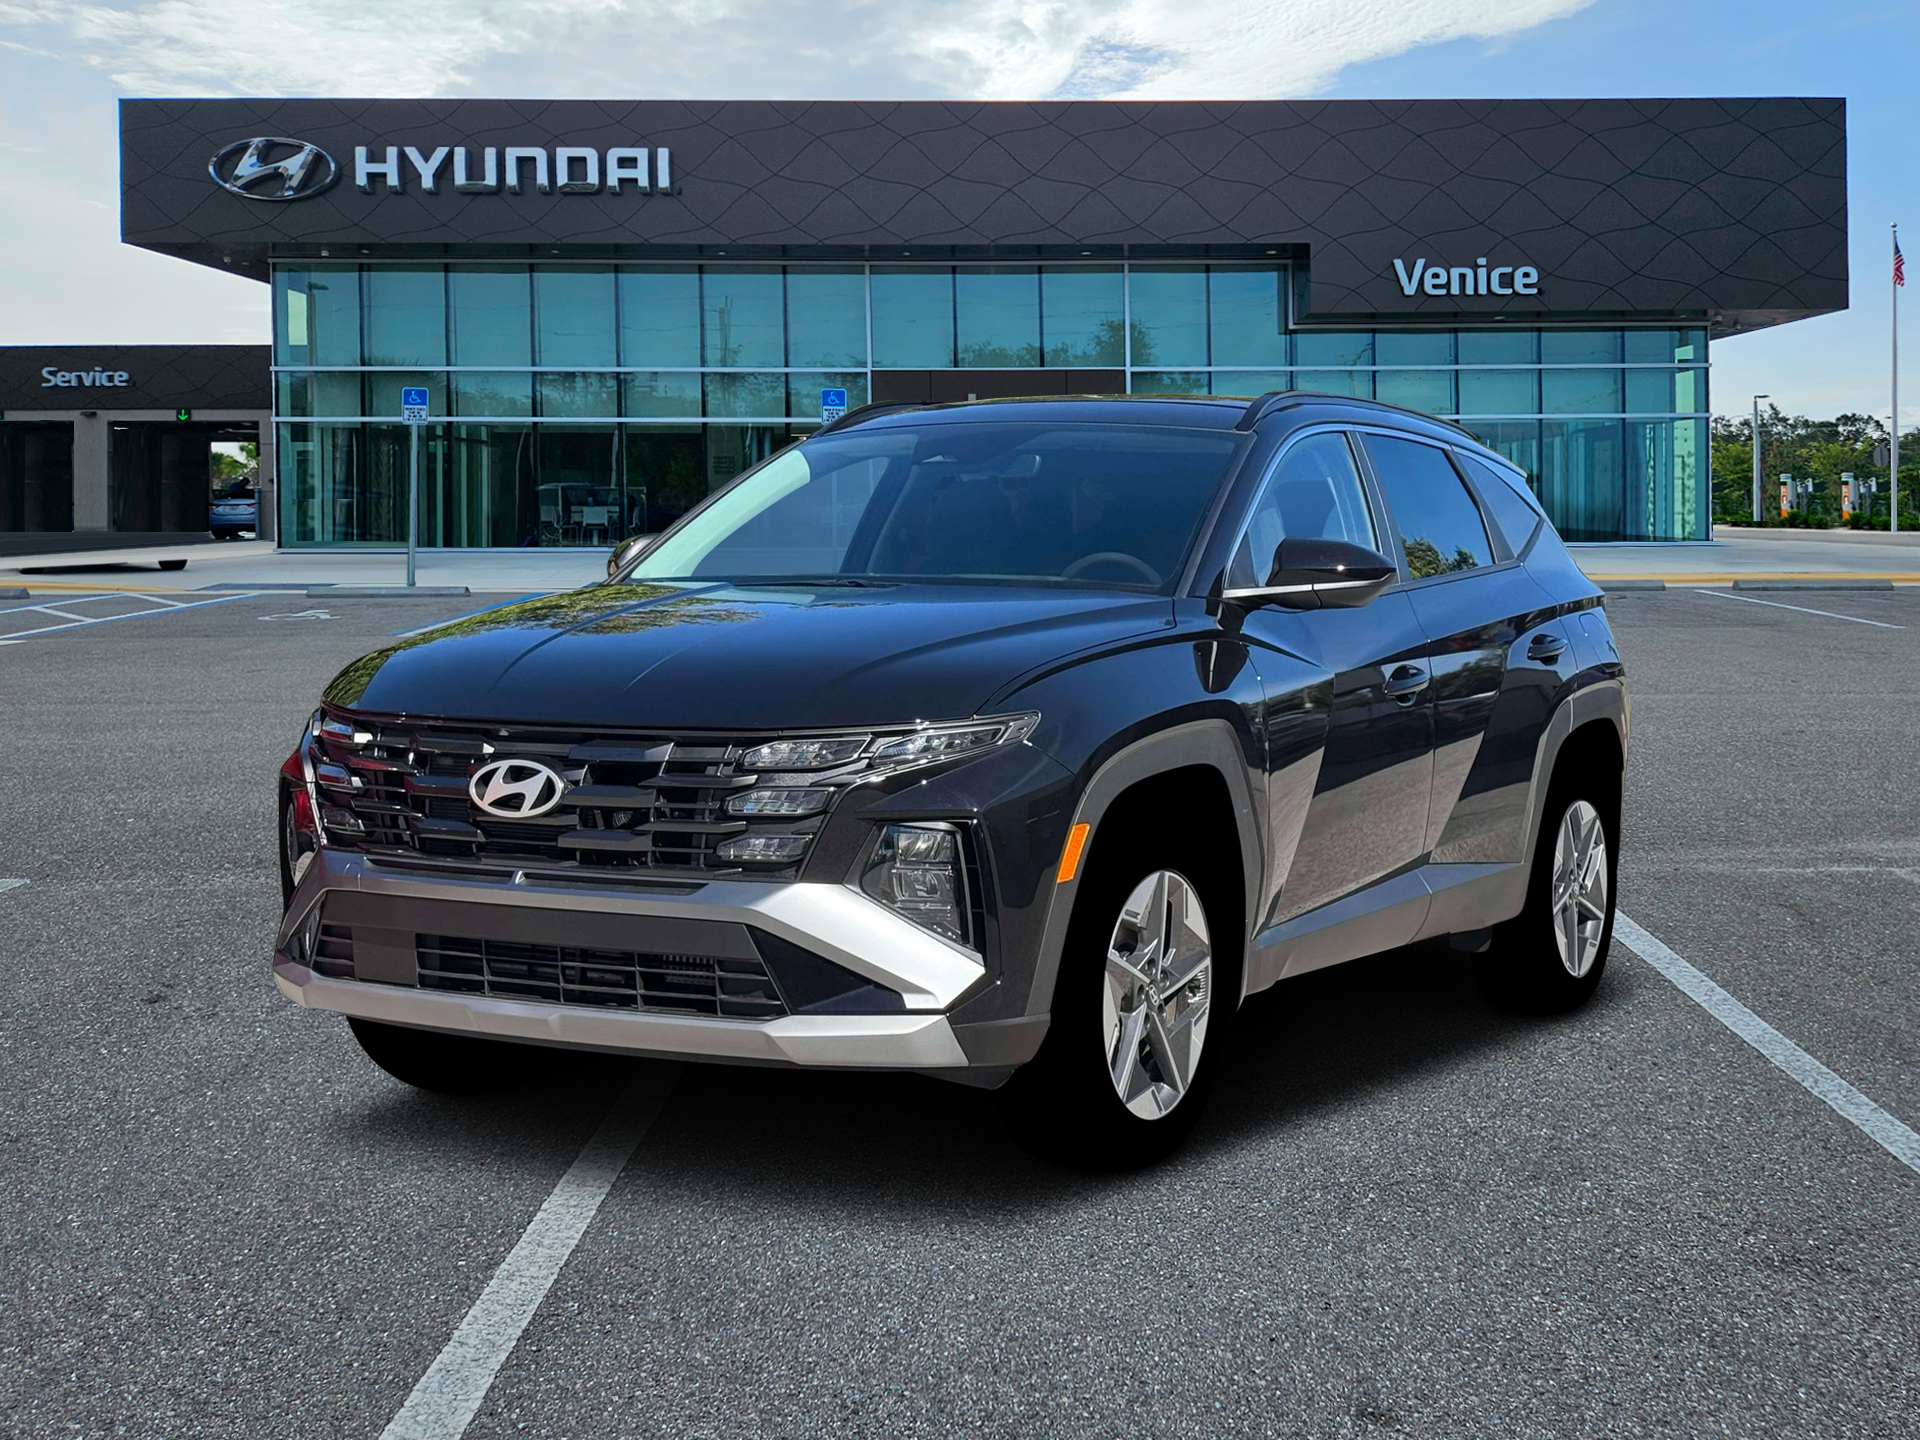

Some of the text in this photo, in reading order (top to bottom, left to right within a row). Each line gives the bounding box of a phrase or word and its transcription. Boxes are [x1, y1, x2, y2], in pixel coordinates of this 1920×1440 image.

[354, 146, 672, 194] HYUNDAI
[1393, 257, 1539, 295] Venice
[41, 366, 130, 387] Service
